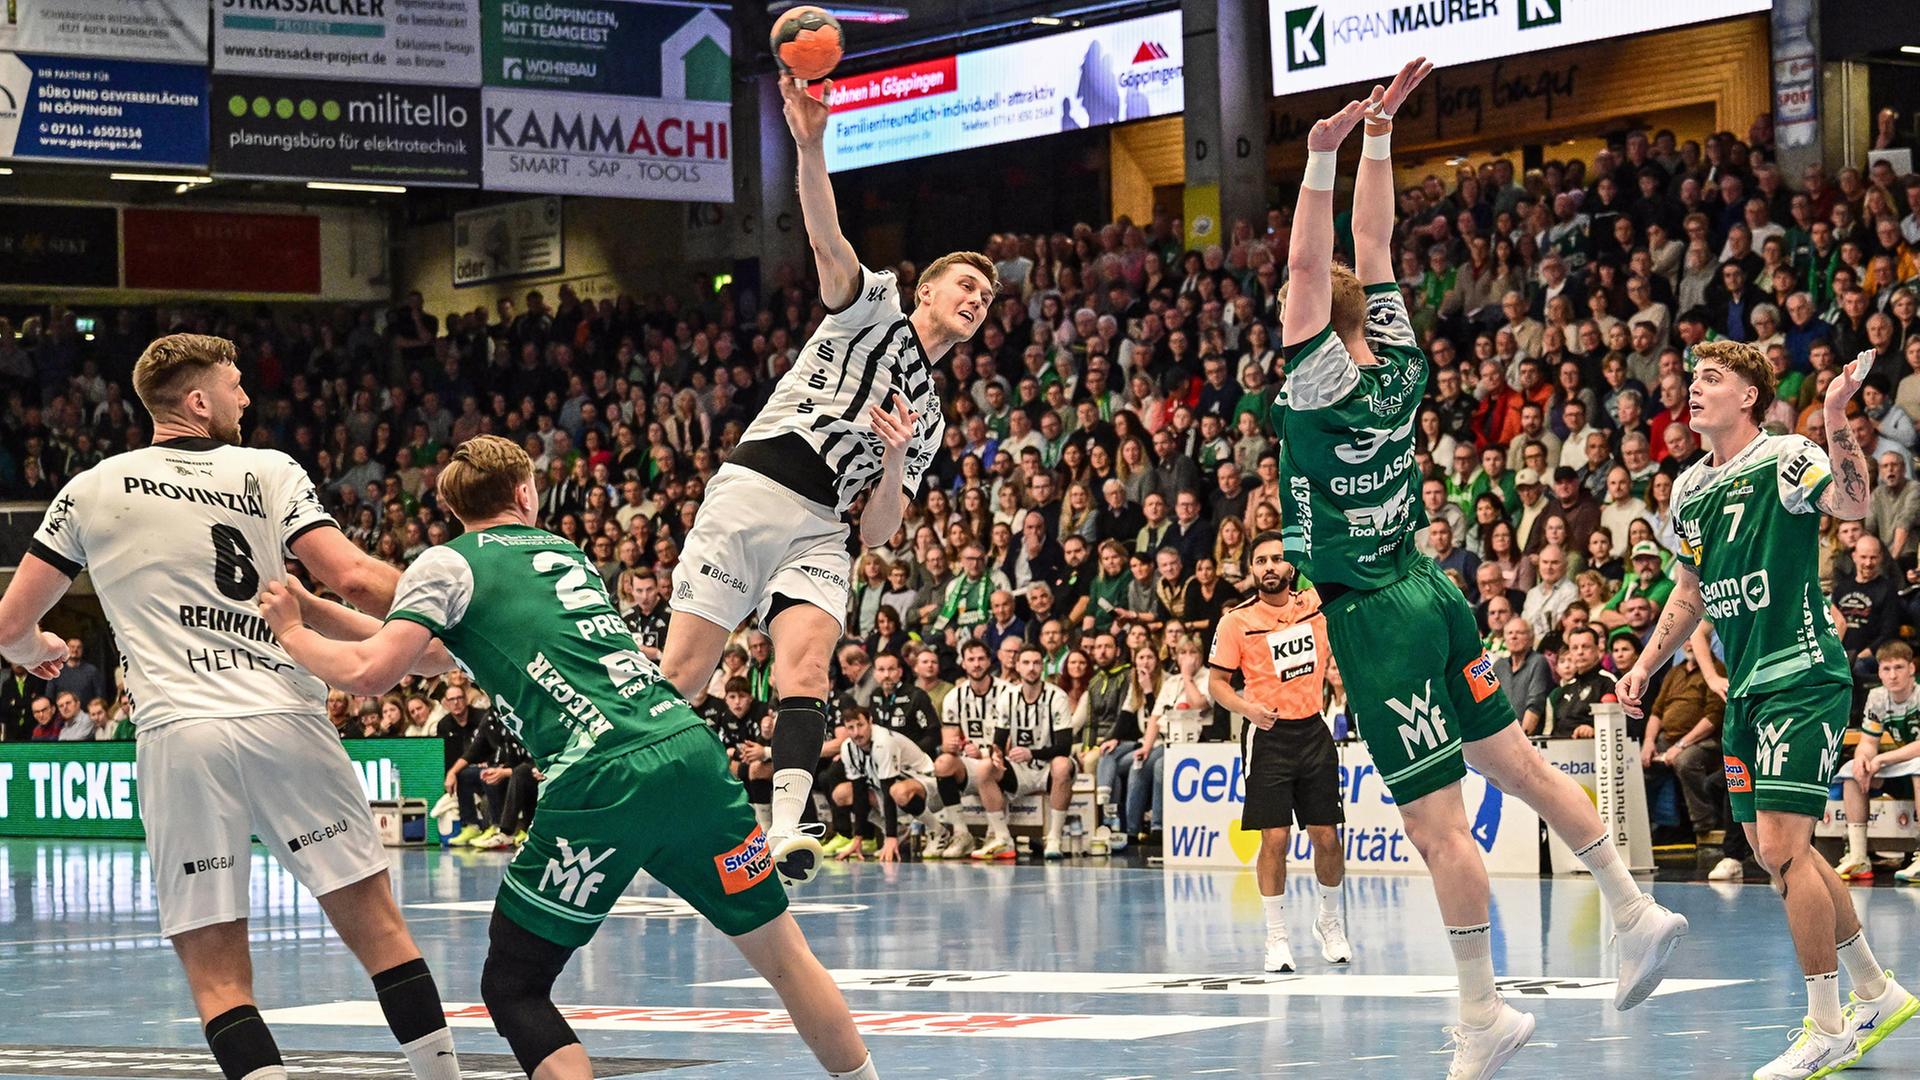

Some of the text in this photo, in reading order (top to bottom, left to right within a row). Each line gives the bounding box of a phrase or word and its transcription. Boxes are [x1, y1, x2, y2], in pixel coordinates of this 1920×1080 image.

[502, 3, 619, 30] FÜR GÖPPINGEN,
[502, 21, 609, 43] MIT TEAMGEIST
[224, 44, 387, 67] www.strassacker-project.de
[526, 58, 598, 78] WOHNBAU
[869, 80, 880, 99] in
[881, 71, 944, 98] Göppingen
[1119, 67, 1183, 89] Göppingen
[38, 85, 70, 99] BÜRO
[73, 88, 99, 101] UND
[38, 102, 123, 117] IN GÖPPINGEN
[350, 92, 468, 128] militello
[836, 107, 937, 138] Familienfreundlich
[50, 123, 84, 135] 07161
[229, 129, 468, 155] planungsbüro für elektrotechnik
[486, 108, 730, 160] KAMMACHI
[509, 156, 702, 182] SMART SAP TOOLS
[1723, 503, 1745, 543] 7
[211, 523, 260, 601] 6
[710, 568, 748, 593] BIG-BAU
[180, 605, 281, 648] REINKIN
[1272, 634, 1314, 661] KÜS
[1286, 664, 1312, 680] kues.de
[1601, 728, 1611, 824] shuttle.com
[1613, 727, 1629, 847] ip-shuttle.com
[1835, 809, 1879, 823] Ener
[300, 820, 348, 847] BIG-BAU
[1171, 825, 1220, 858] Wir
